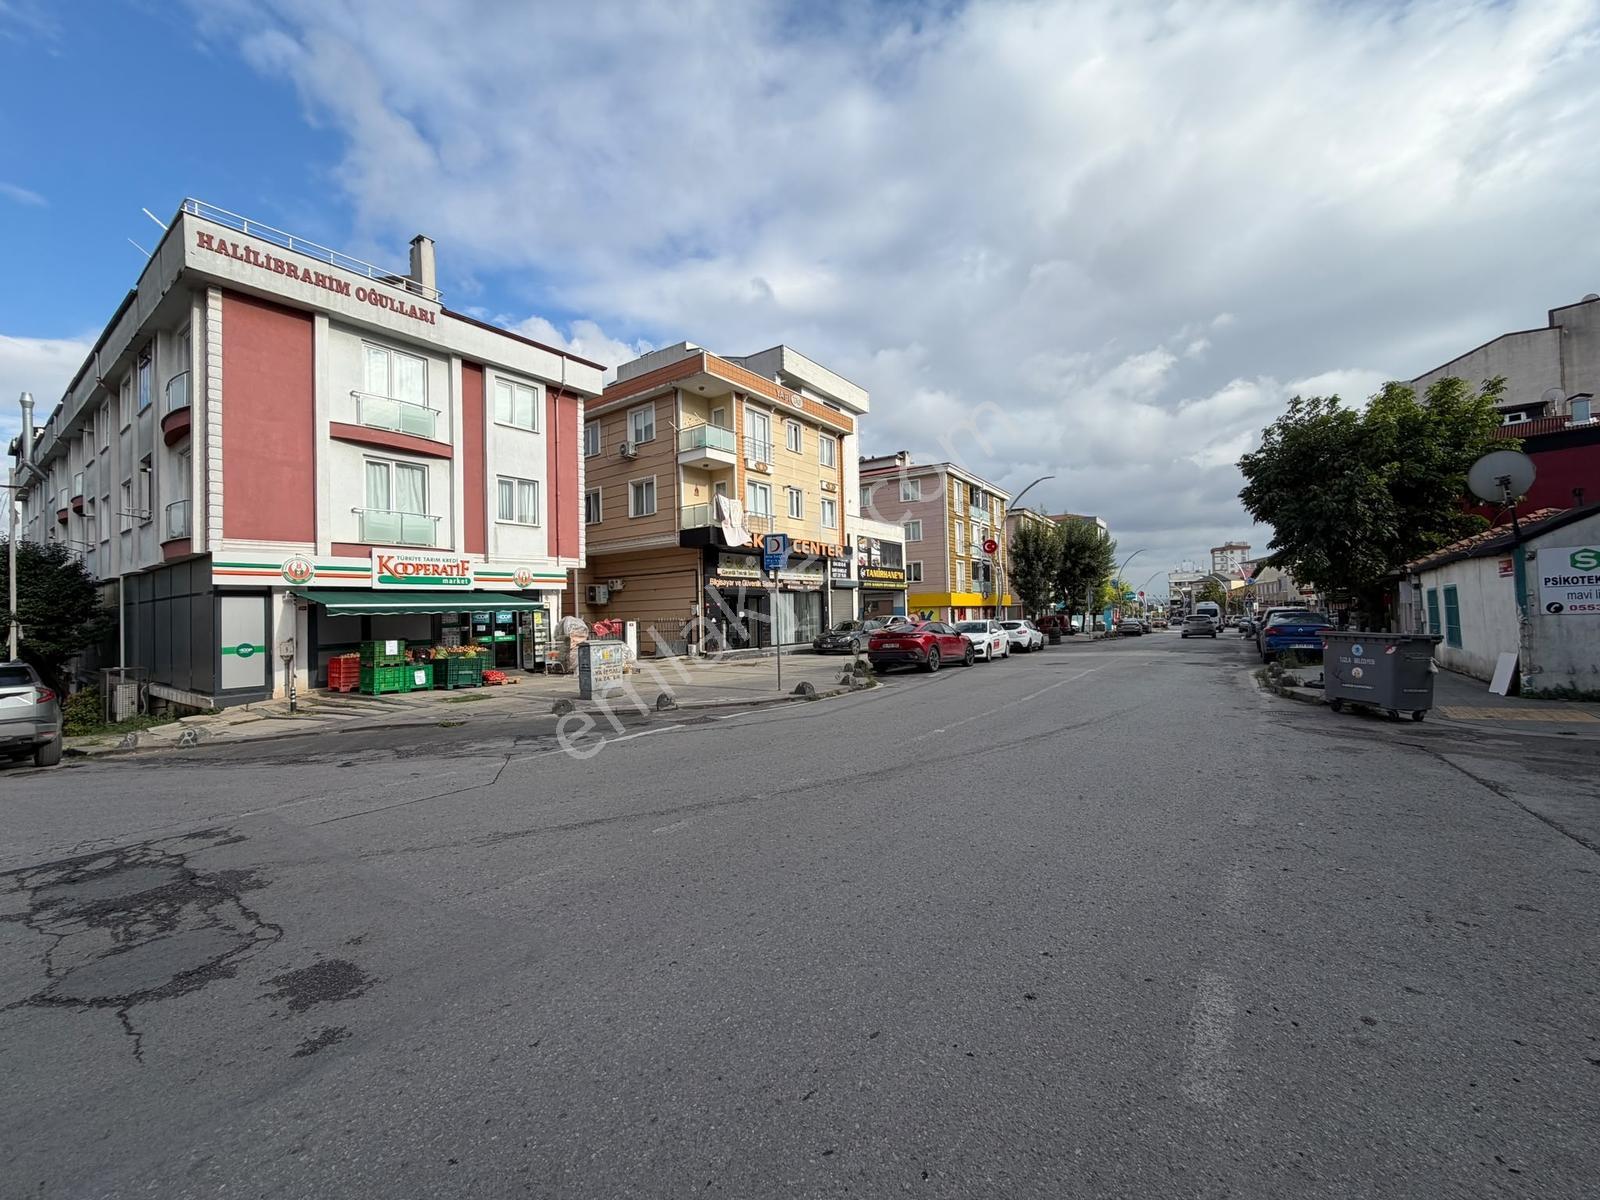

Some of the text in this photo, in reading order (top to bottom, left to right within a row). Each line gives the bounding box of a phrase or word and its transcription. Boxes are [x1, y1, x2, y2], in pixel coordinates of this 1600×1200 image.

[355, 286, 436, 325] OĞULLARI
[793, 539, 844, 558] CENTER
[1543, 574, 1600, 586] PSİKOTEK
[1567, 589, 1593, 600] mavi
